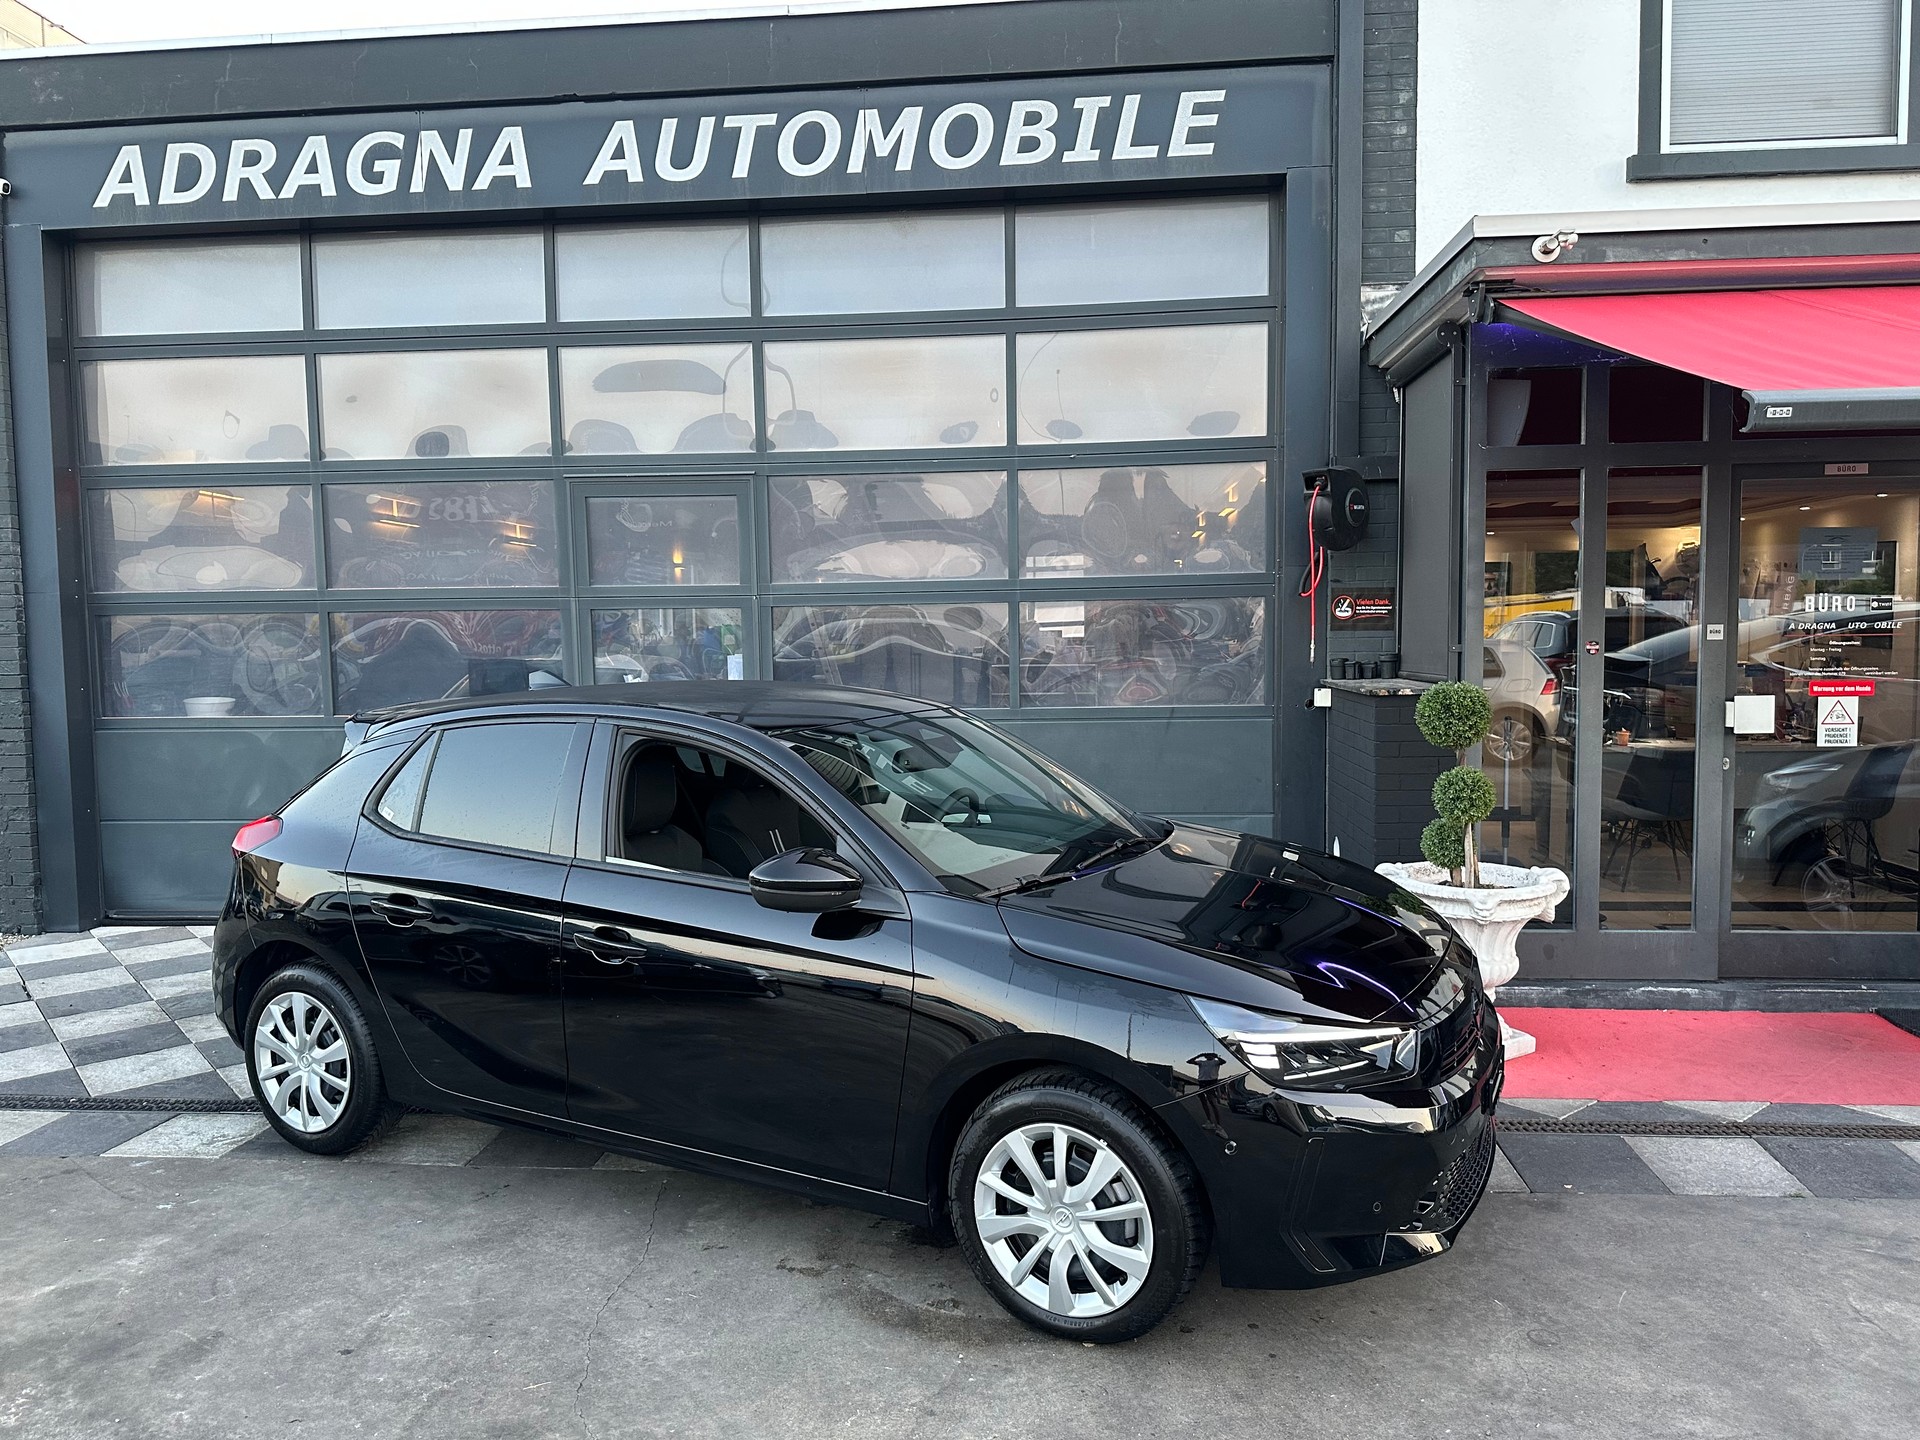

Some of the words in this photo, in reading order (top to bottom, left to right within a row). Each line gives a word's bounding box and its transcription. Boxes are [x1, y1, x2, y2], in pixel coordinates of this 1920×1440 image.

[93, 125, 532, 208] ADRAGNA
[583, 89, 1227, 186] AUTOMOBILE
[1837, 464, 1857, 473] BÜRO
[1805, 592, 1856, 613] BÜRO
[1813, 685, 1835, 693] Warnung
